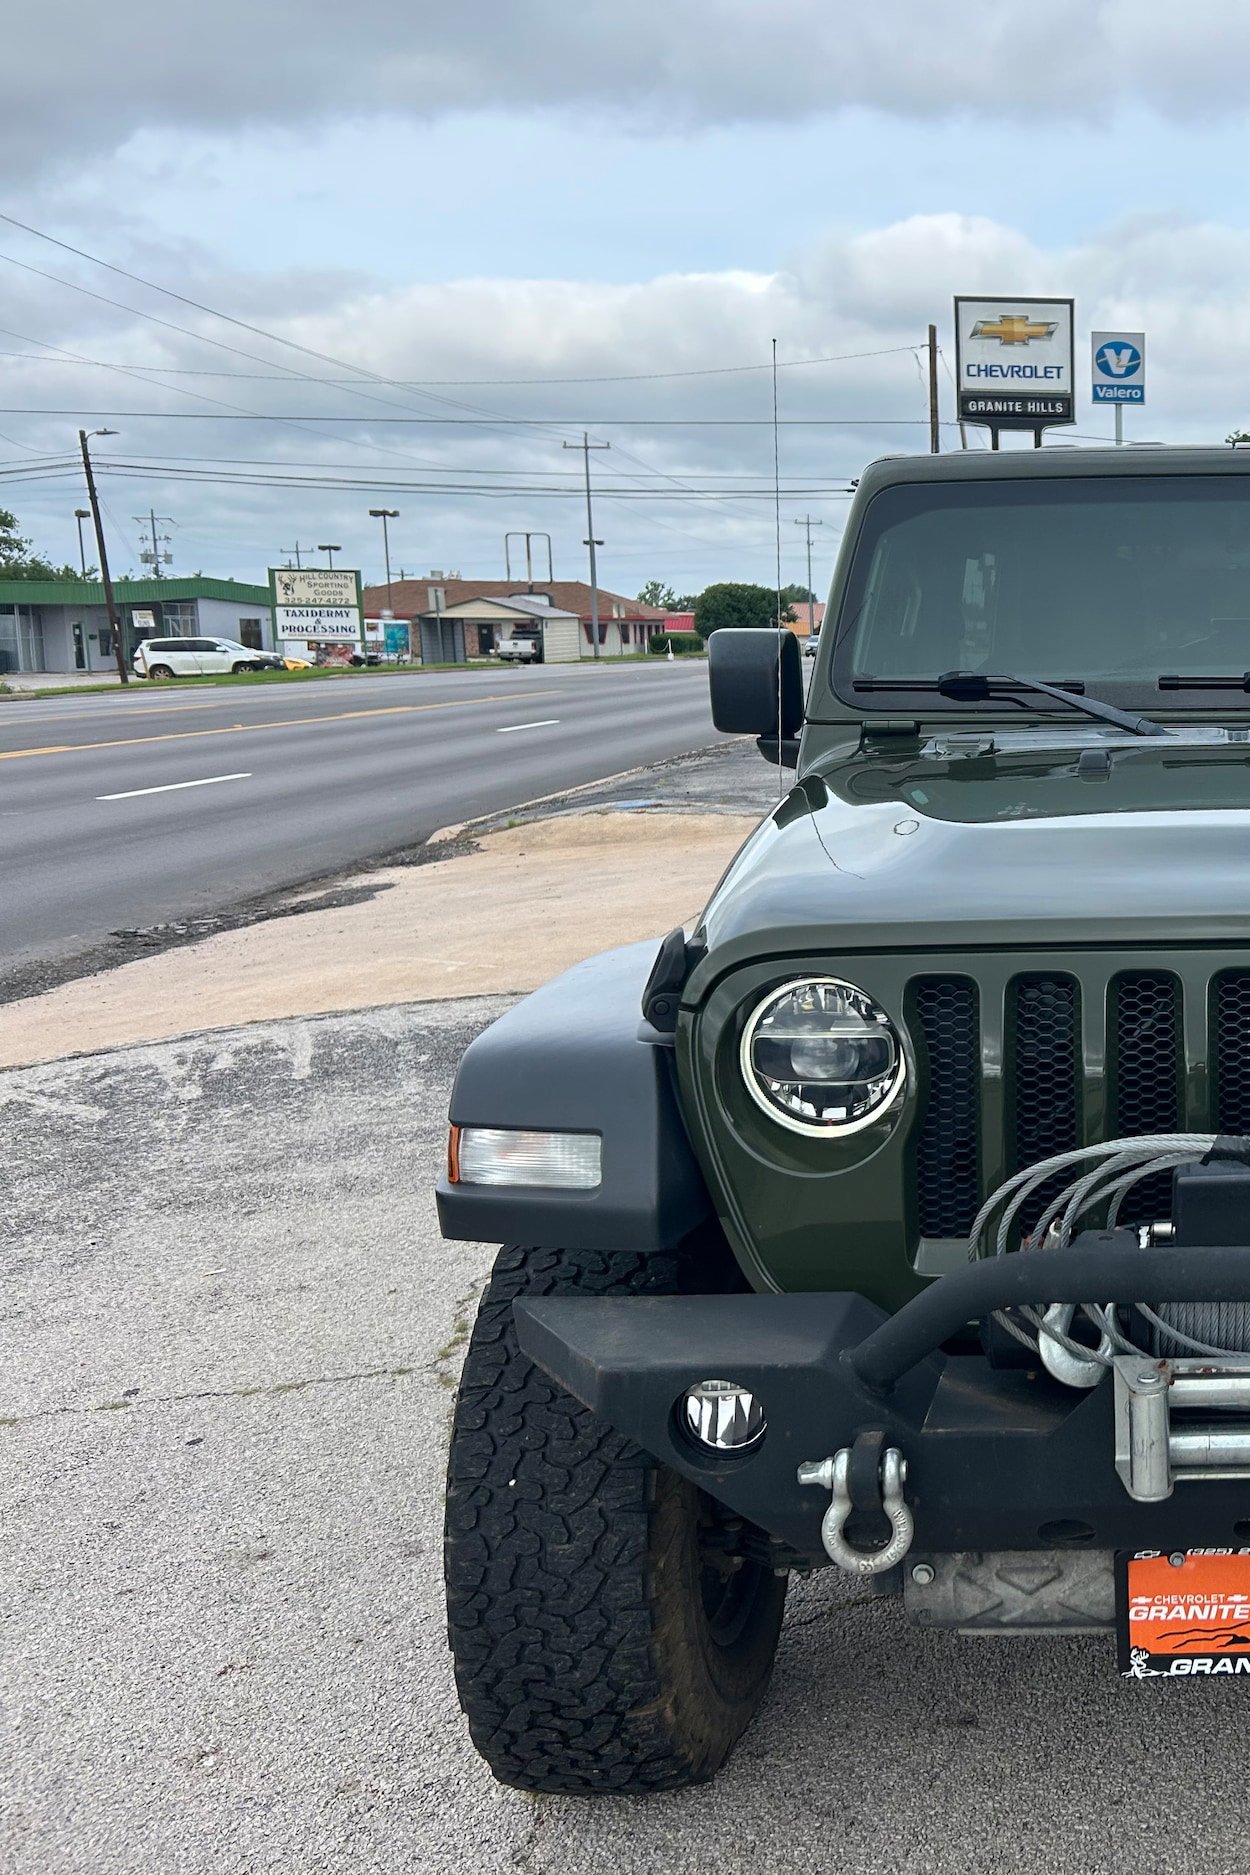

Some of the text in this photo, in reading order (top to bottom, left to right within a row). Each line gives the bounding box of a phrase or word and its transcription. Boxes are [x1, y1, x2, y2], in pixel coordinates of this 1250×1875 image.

[966, 364, 1064, 379] CHEVROLET
[1096, 386, 1141, 398] Valero
[968, 400, 1064, 413] GRANITE HILLS
[300, 572, 354, 583] HILL COUNTRY
[283, 609, 350, 617] TAXIDERMY
[281, 625, 356, 633] PROCESSING
[1154, 1594, 1225, 1604] CHEVROLET
[1129, 1604, 1250, 1621] GRANITE
